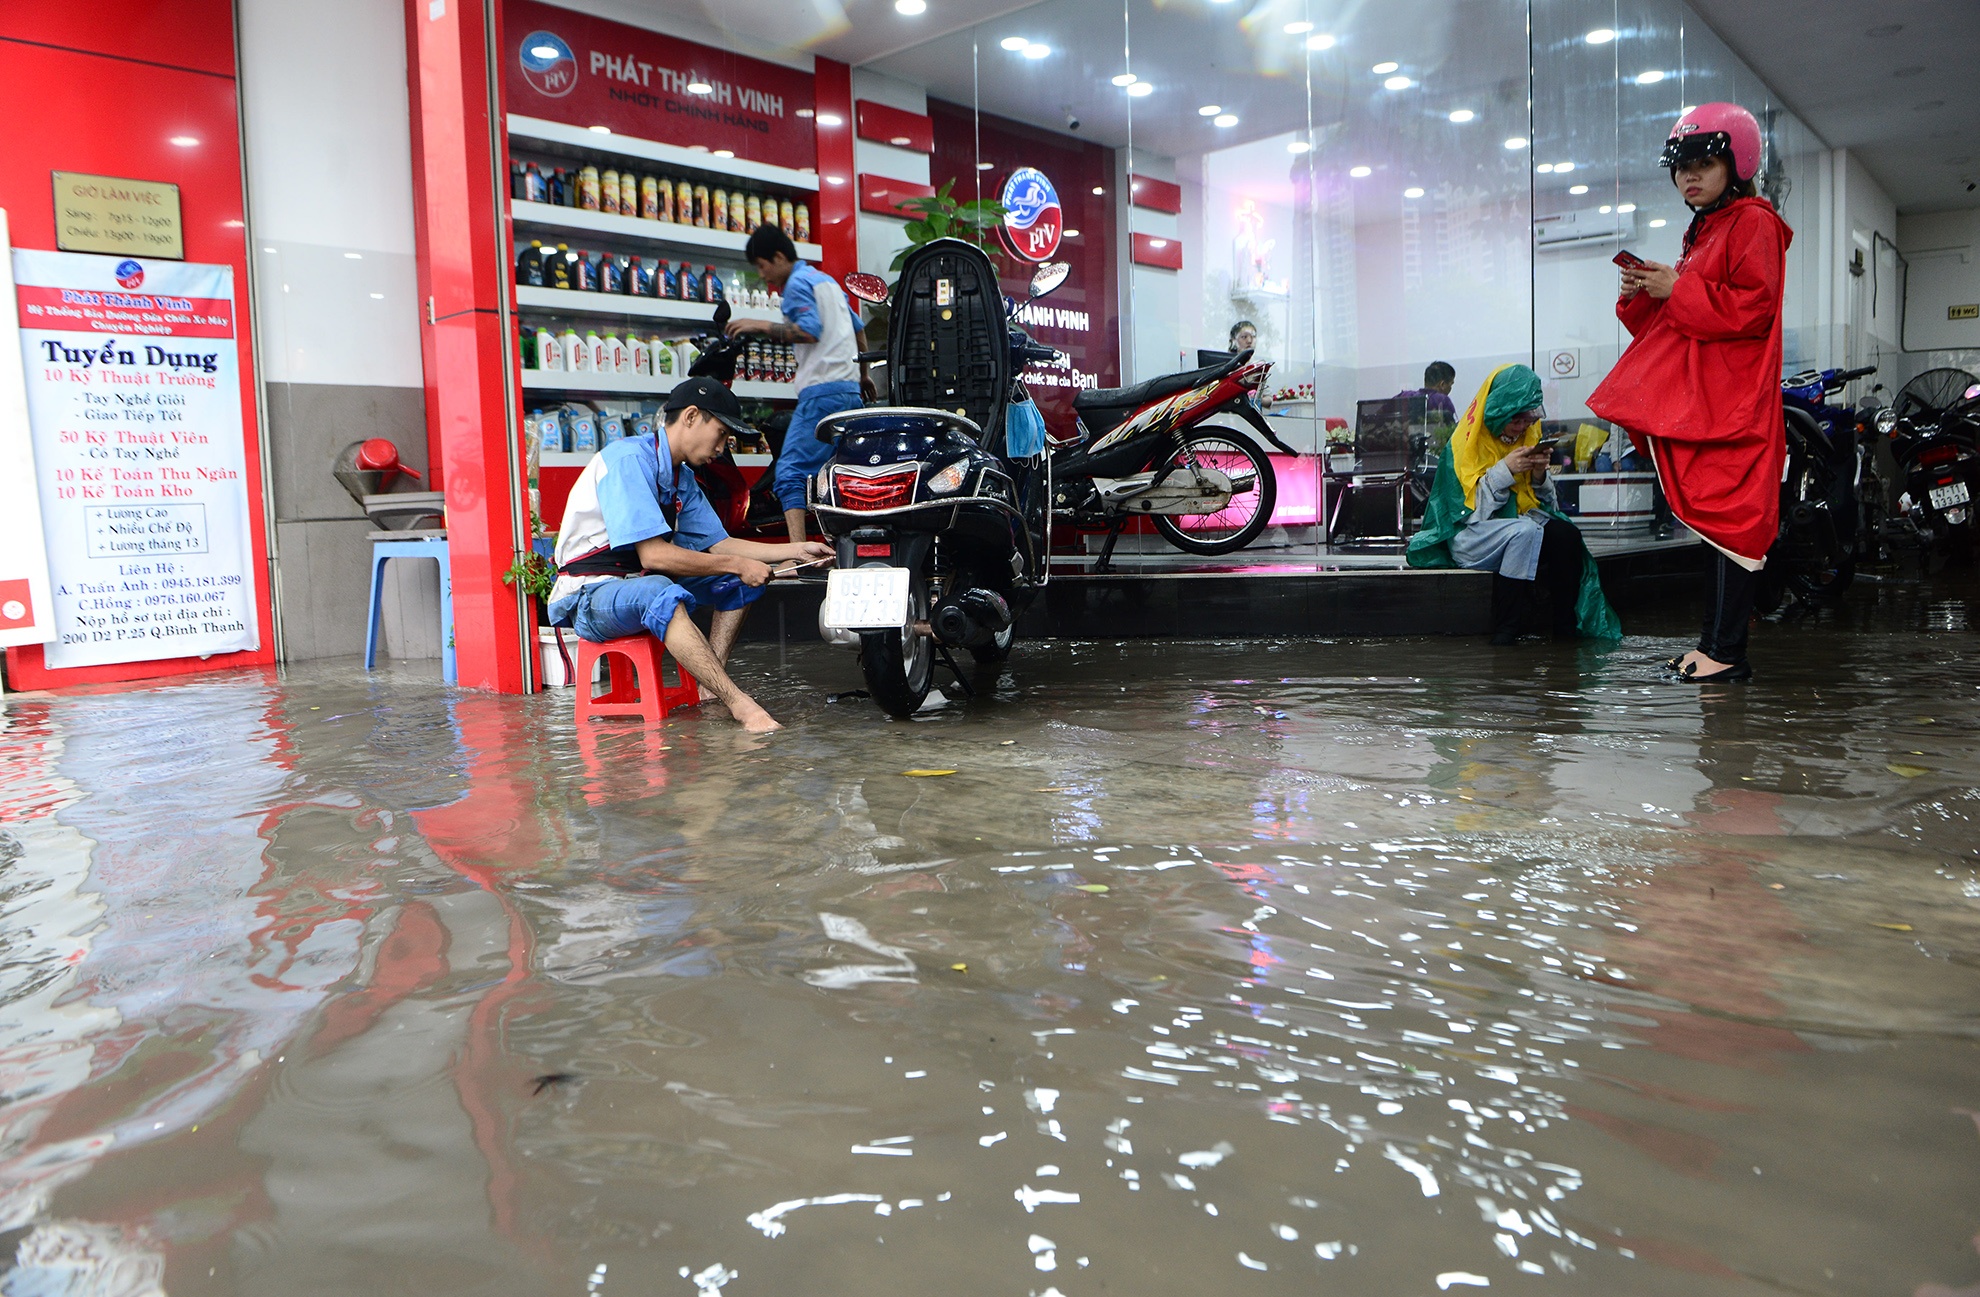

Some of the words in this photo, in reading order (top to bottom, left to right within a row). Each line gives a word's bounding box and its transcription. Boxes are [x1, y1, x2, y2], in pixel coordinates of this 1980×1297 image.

[590, 51, 653, 87] PHÁT
[736, 85, 784, 119] VINH
[609, 87, 659, 109] NHỚT
[665, 97, 720, 123] CHÍNH
[101, 186, 131, 202] LÀM
[1029, 223, 1055, 253] PTV
[61, 289, 101, 306] Phát
[102, 291, 153, 310] Thành
[154, 296, 193, 311] Vinh
[1008, 301, 1054, 328] HÀNH
[1055, 308, 1089, 332] VINH
[1963, 307, 1976, 315] WC
[41, 339, 136, 368] Tuyển
[144, 345, 218, 373] Dụng
[44, 369, 63, 382] 10
[100, 369, 151, 387] Thuật
[83, 392, 108, 406] Tay
[84, 409, 118, 421] Giao
[123, 408, 155, 423] Tiếp
[158, 407, 183, 421] Tốt
[60, 431, 78, 444] 50
[115, 430, 165, 447] Thuật
[170, 431, 209, 444] Viên
[89, 446, 109, 459] Có
[114, 447, 140, 460] Tay
[56, 468, 74, 481] 10
[80, 465, 105, 481] Kế
[110, 467, 154, 481] Toán
[158, 467, 191, 480] Thu
[196, 466, 238, 482] Ngân
[57, 486, 75, 499] 10
[82, 483, 106, 499] Kế
[111, 484, 155, 498] Toán
[160, 484, 193, 497] Kho
[1936, 485, 1960, 498] 47-T1
[107, 508, 142, 521] Lương
[145, 507, 168, 518] Cao
[109, 521, 145, 535] Nhiều
[148, 520, 173, 534] Chế
[176, 521, 193, 535] Độ
[109, 540, 145, 553] Lương
[148, 538, 182, 552] tháng
[185, 538, 199, 548] 13
[119, 563, 152, 576] Liên
[156, 562, 175, 574] Hệ
[57, 584, 73, 596] A.
[78, 580, 116, 594] Tuấn
[120, 580, 150, 592] Anh
[841, 574, 894, 596] 69-F1
[78, 596, 133, 611] C.Hồng
[144, 591, 225, 607] 0976.160.067
[75, 615, 107, 629] Nộp
[111, 611, 129, 625] hồ
[134, 612, 150, 623] sơ
[154, 610, 172, 623] tại
[177, 608, 199, 621] địa
[63, 632, 87, 645] 200
[92, 630, 111, 643] D2
[117, 627, 146, 641] P.25
[150, 623, 198, 640] Q.Bình
[201, 620, 245, 636] Thạnh
